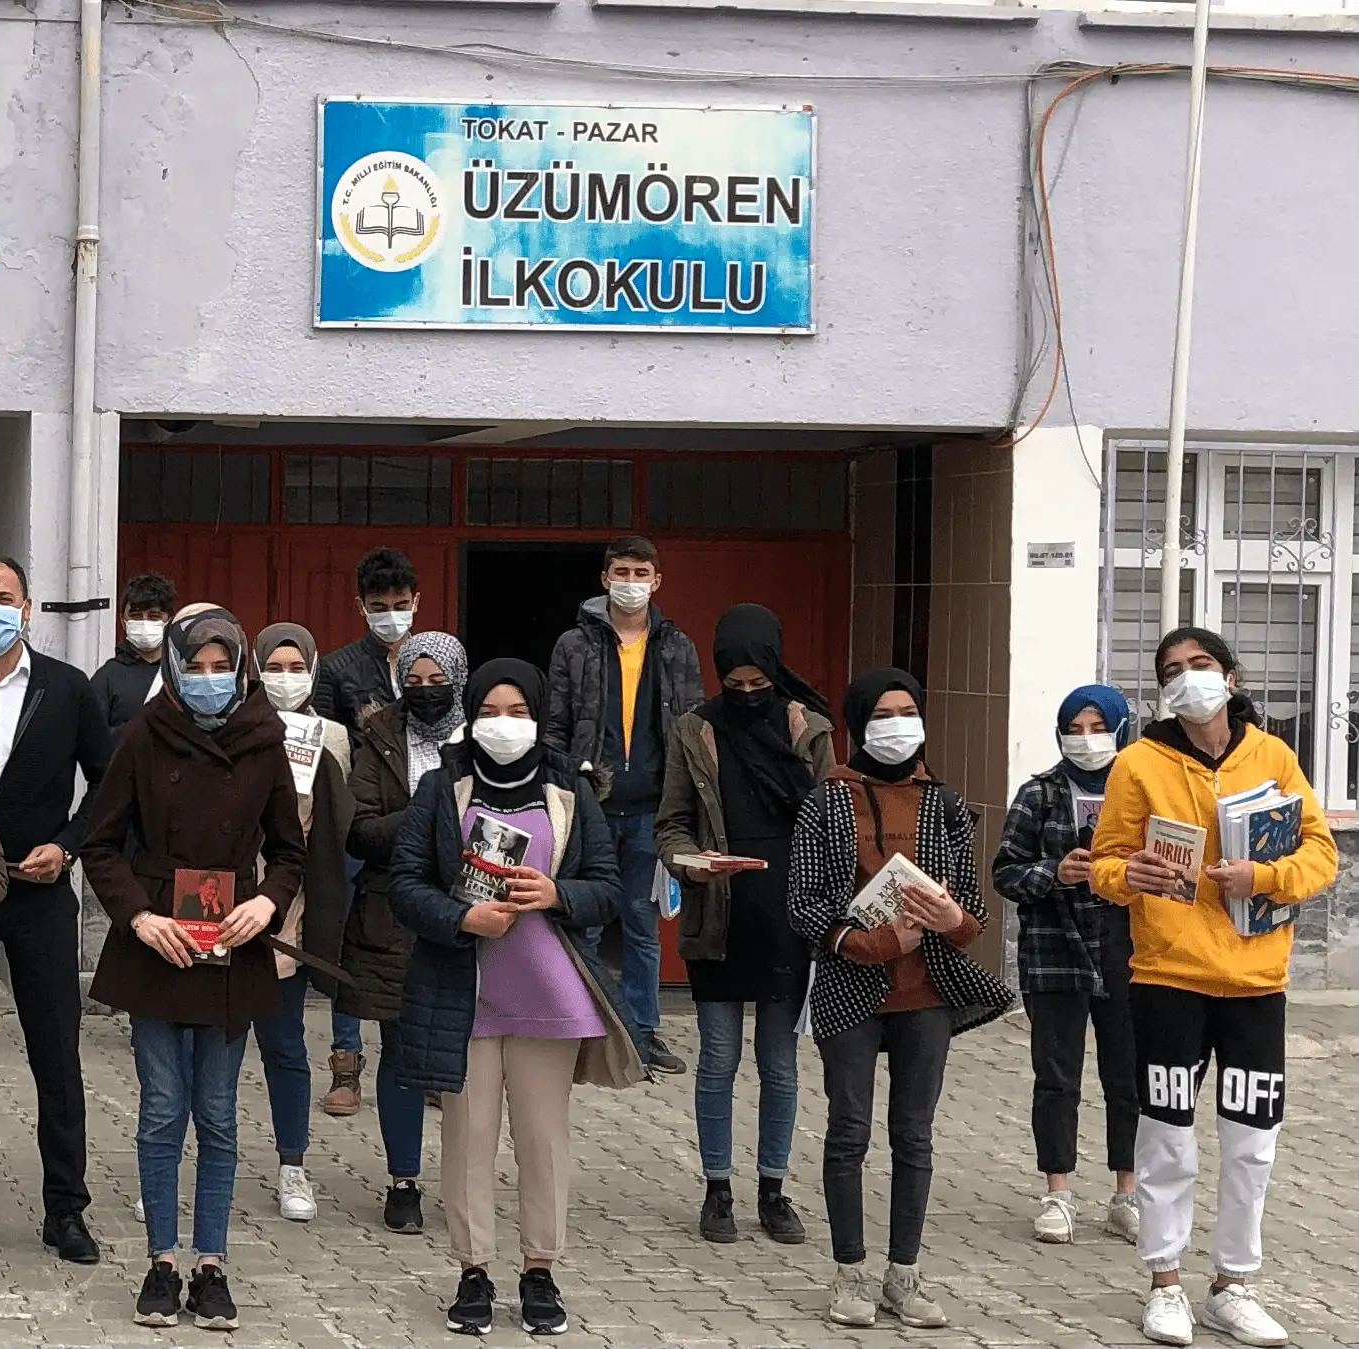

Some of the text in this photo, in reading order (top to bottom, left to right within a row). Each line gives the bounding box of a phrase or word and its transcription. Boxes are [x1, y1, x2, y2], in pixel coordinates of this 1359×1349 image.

[461, 118, 549, 142] TOKAT
[572, 121, 659, 144] PAZAR
[462, 157, 803, 225] ÜZÜMÖREN
[460, 245, 766, 312] İLKOKULU
[1221, 1067, 1285, 1118] OFF
